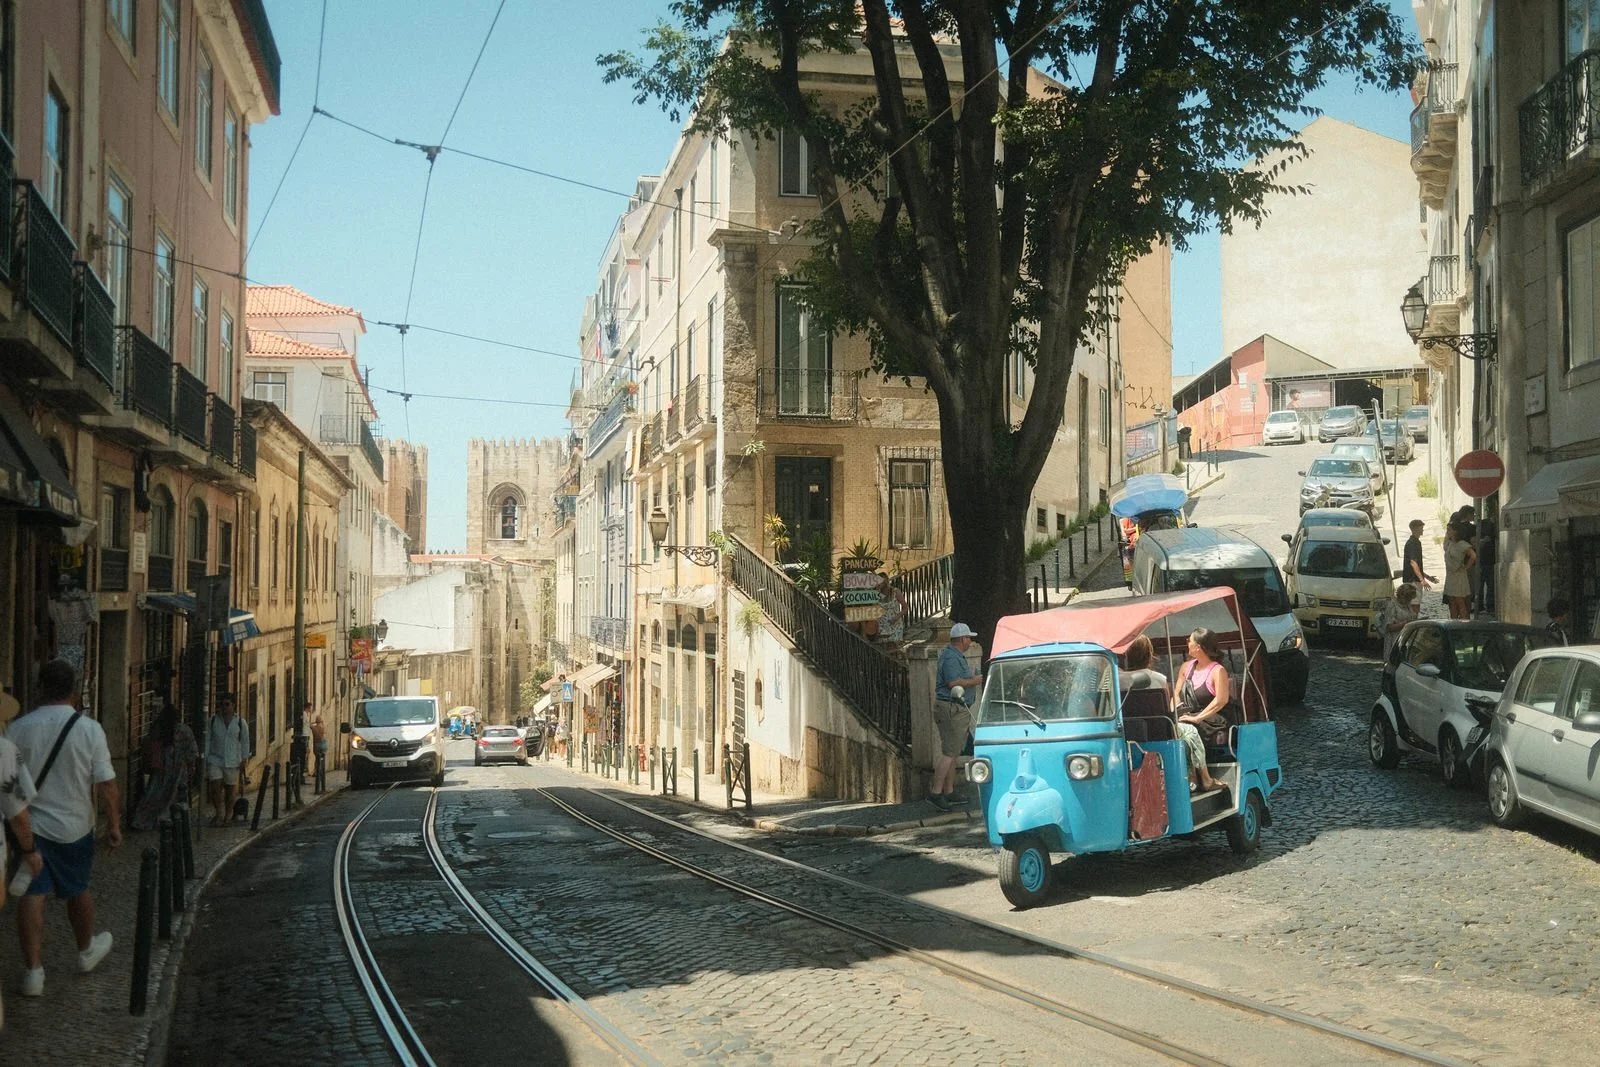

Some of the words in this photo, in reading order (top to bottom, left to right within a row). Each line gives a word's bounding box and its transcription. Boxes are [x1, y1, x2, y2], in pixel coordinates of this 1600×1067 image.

[844, 559, 882, 569] PANCAKES
[845, 575, 879, 587] BOWLS
[846, 607, 882, 621] JUICES
